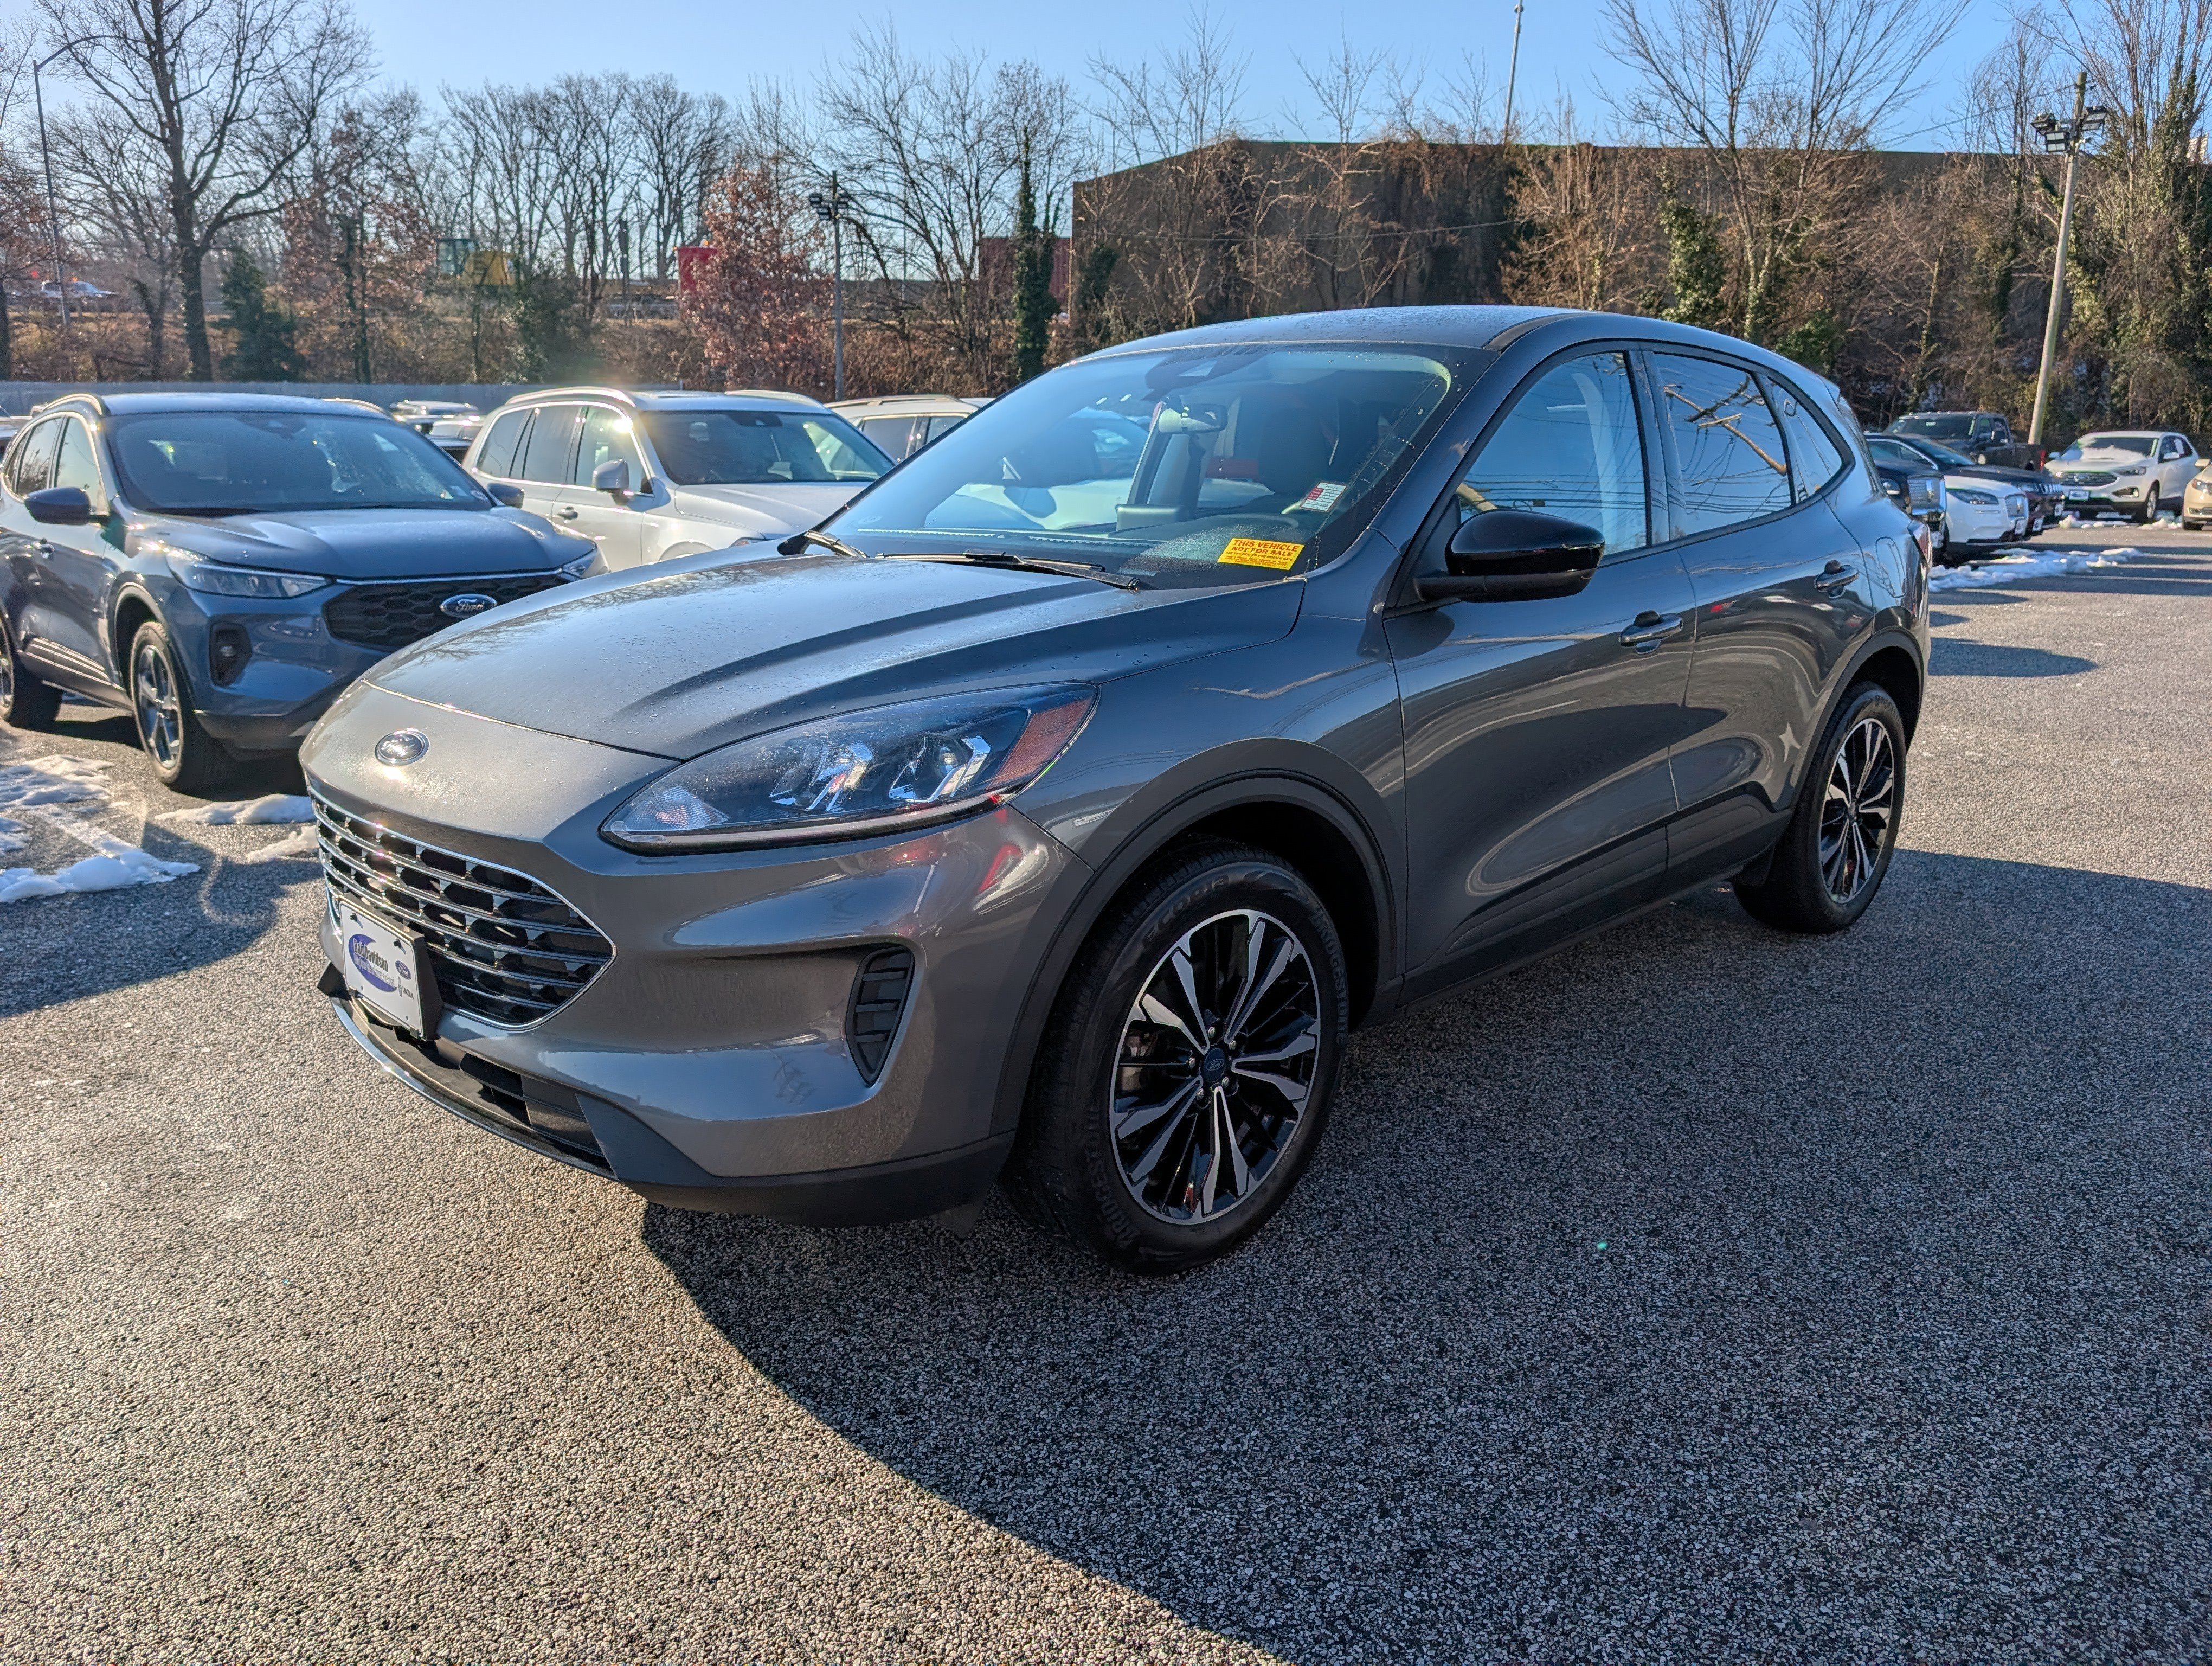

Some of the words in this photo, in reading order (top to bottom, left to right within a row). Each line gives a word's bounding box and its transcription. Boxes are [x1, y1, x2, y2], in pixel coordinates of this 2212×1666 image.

[1256, 542, 1300, 552] VEHICLE
[455, 599, 485, 612] Ford
[364, 945, 388, 973] Davidson
[398, 963, 408, 977] Ford
[1309, 908, 1348, 1046] BRIDGESTONE
[402, 986, 414, 999] LINCOLN
[1209, 1060, 1222, 1069] Ford
